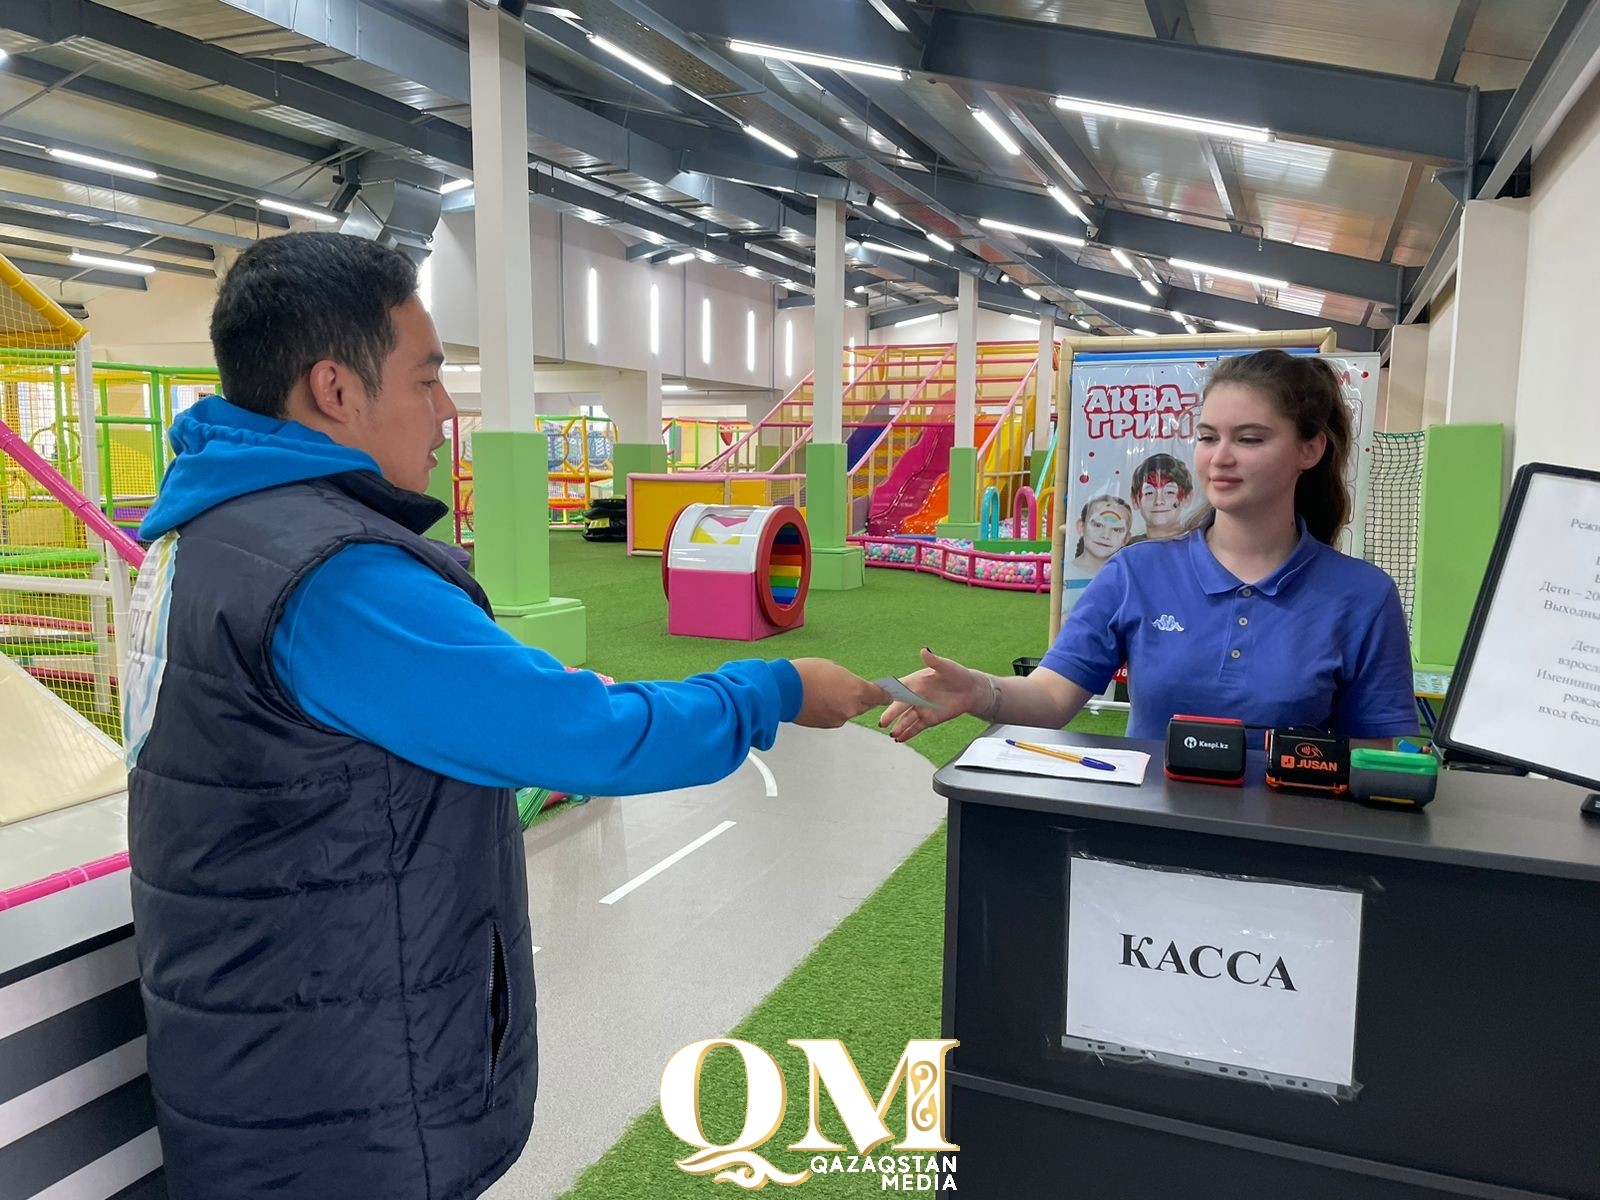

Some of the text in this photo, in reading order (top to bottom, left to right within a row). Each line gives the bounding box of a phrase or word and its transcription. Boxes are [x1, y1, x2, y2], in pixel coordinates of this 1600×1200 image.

[1084, 384, 1199, 414] АКВА-
[1086, 411, 1194, 440] ГРИМ
[1539, 580, 1570, 596] Дети
[1538, 705, 1567, 720] вход
[1198, 740, 1229, 750] Kaspi.kz
[1296, 758, 1337, 772] JUSAN
[1118, 932, 1298, 992] КАССА
